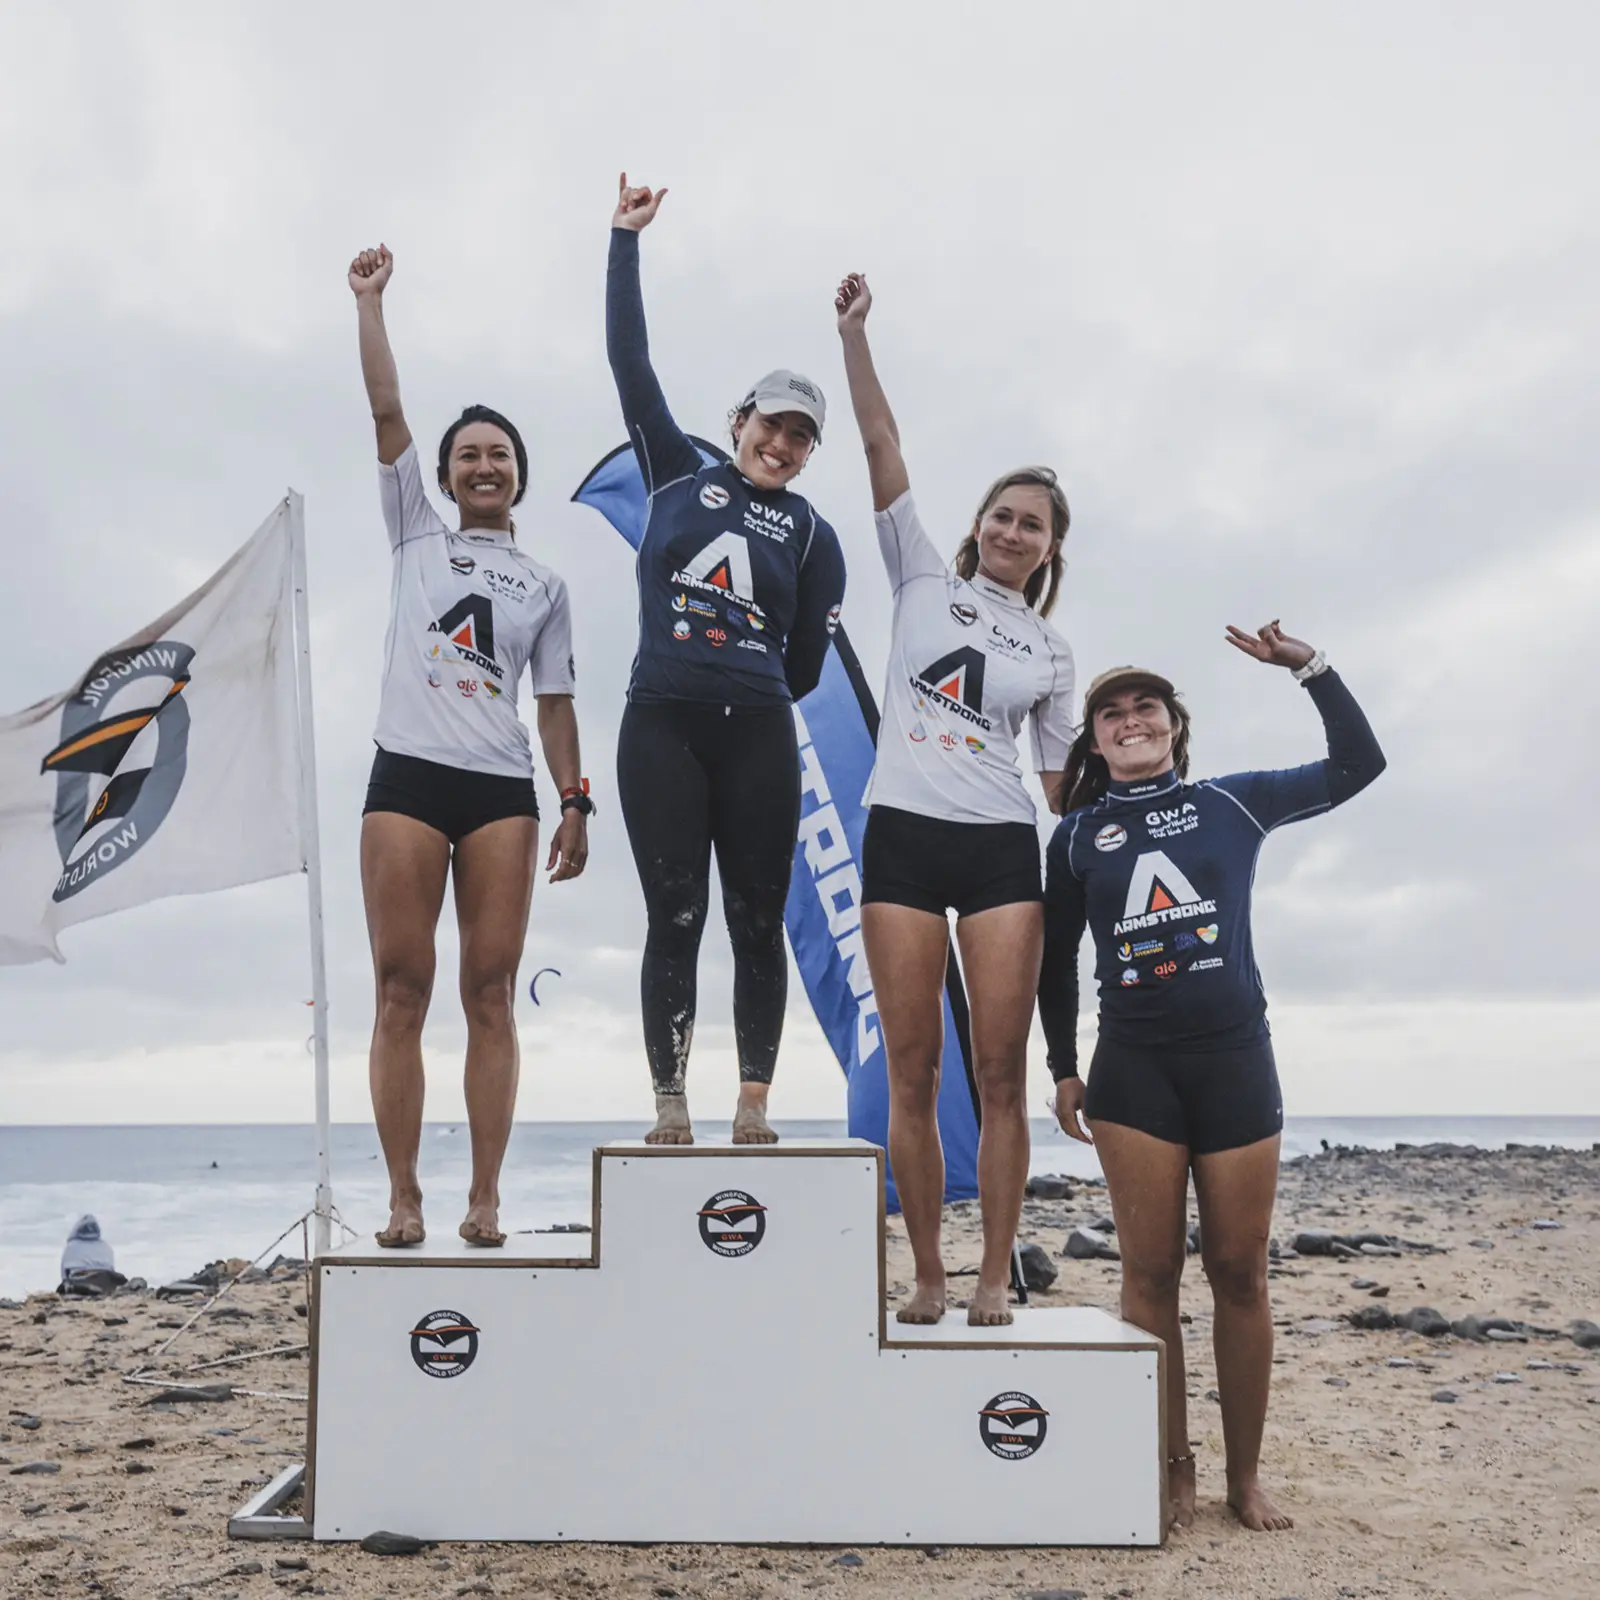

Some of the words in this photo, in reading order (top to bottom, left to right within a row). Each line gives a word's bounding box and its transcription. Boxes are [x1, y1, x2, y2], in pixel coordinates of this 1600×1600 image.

[1145, 802, 1197, 826] GWA
[1113, 898, 1217, 936] ARMSTRONG
[715, 1191, 748, 1202] WINGFOIL
[721, 1233, 743, 1241] GWA
[712, 1242, 736, 1256] WORLD
[736, 1242, 754, 1255] TOUR
[428, 1311, 461, 1323] WINGFOIL
[423, 1363, 447, 1377] WORLD
[447, 1363, 465, 1377] TOUR
[998, 1393, 1031, 1405] WINGFOIL
[1001, 1435, 1023, 1444] GWA
[991, 1443, 1015, 1459] WORLD
[1015, 1446, 1034, 1459] TOUR
